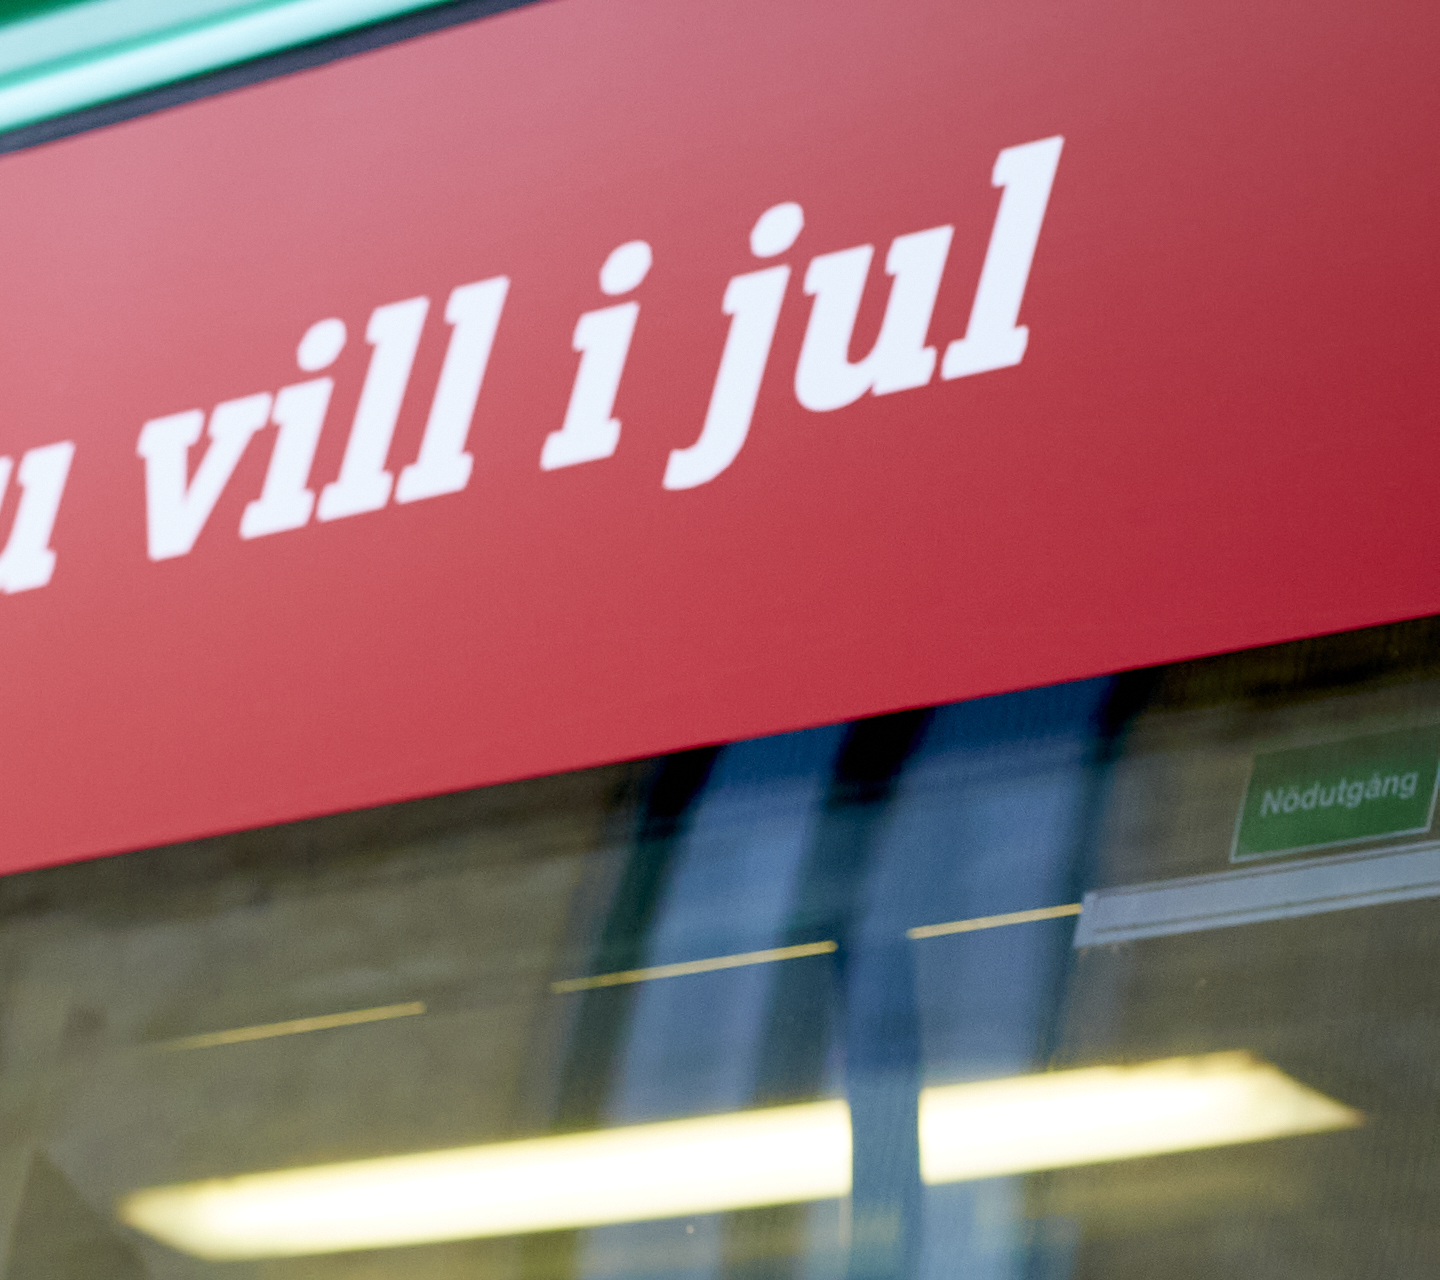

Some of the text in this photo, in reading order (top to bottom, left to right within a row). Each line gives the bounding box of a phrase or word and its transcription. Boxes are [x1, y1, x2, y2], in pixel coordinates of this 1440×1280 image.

[137, 277, 508, 559] vill
[542, 242, 651, 470] i
[665, 137, 1063, 488] jul
[1260, 771, 1418, 818] Nödutgång
